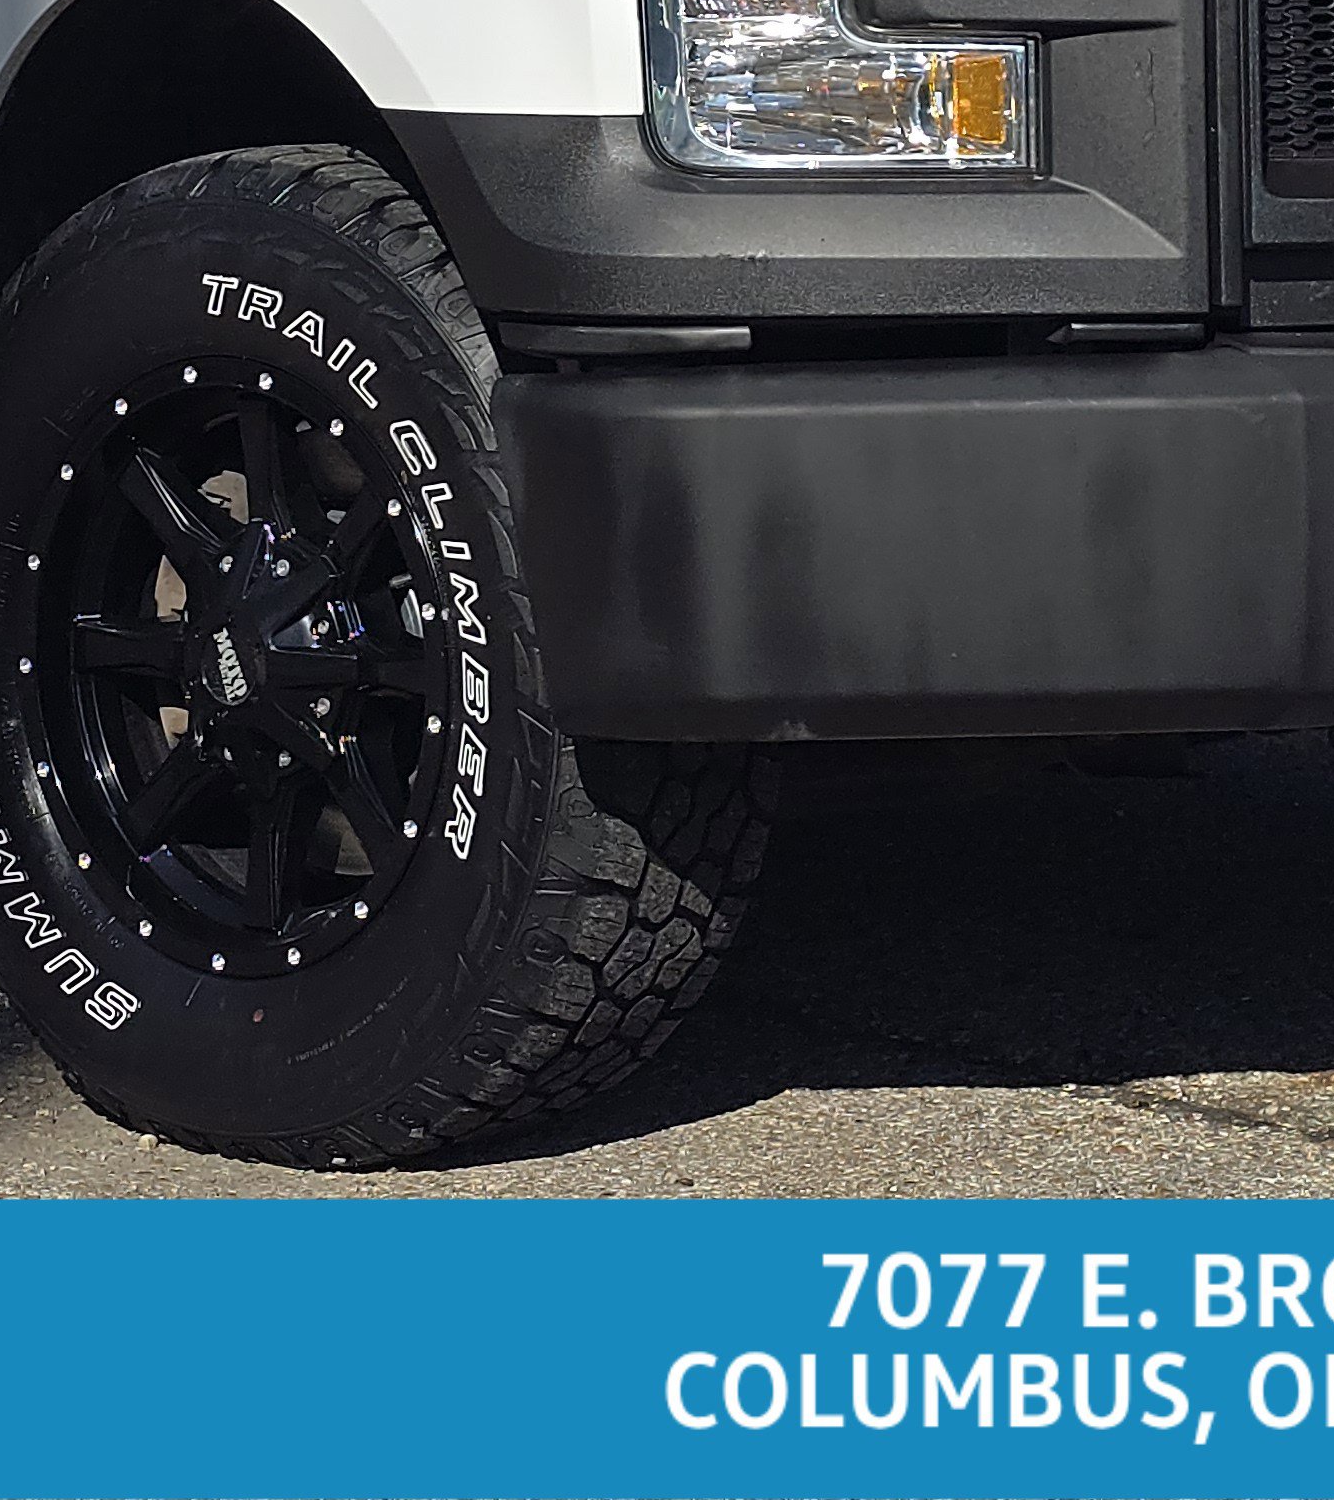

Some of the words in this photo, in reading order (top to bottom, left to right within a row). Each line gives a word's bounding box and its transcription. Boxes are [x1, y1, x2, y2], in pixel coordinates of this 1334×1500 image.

[202, 273, 378, 410] TRAIL
[388, 418, 490, 861] CLIMBER
[212, 627, 248, 697] MOTO
